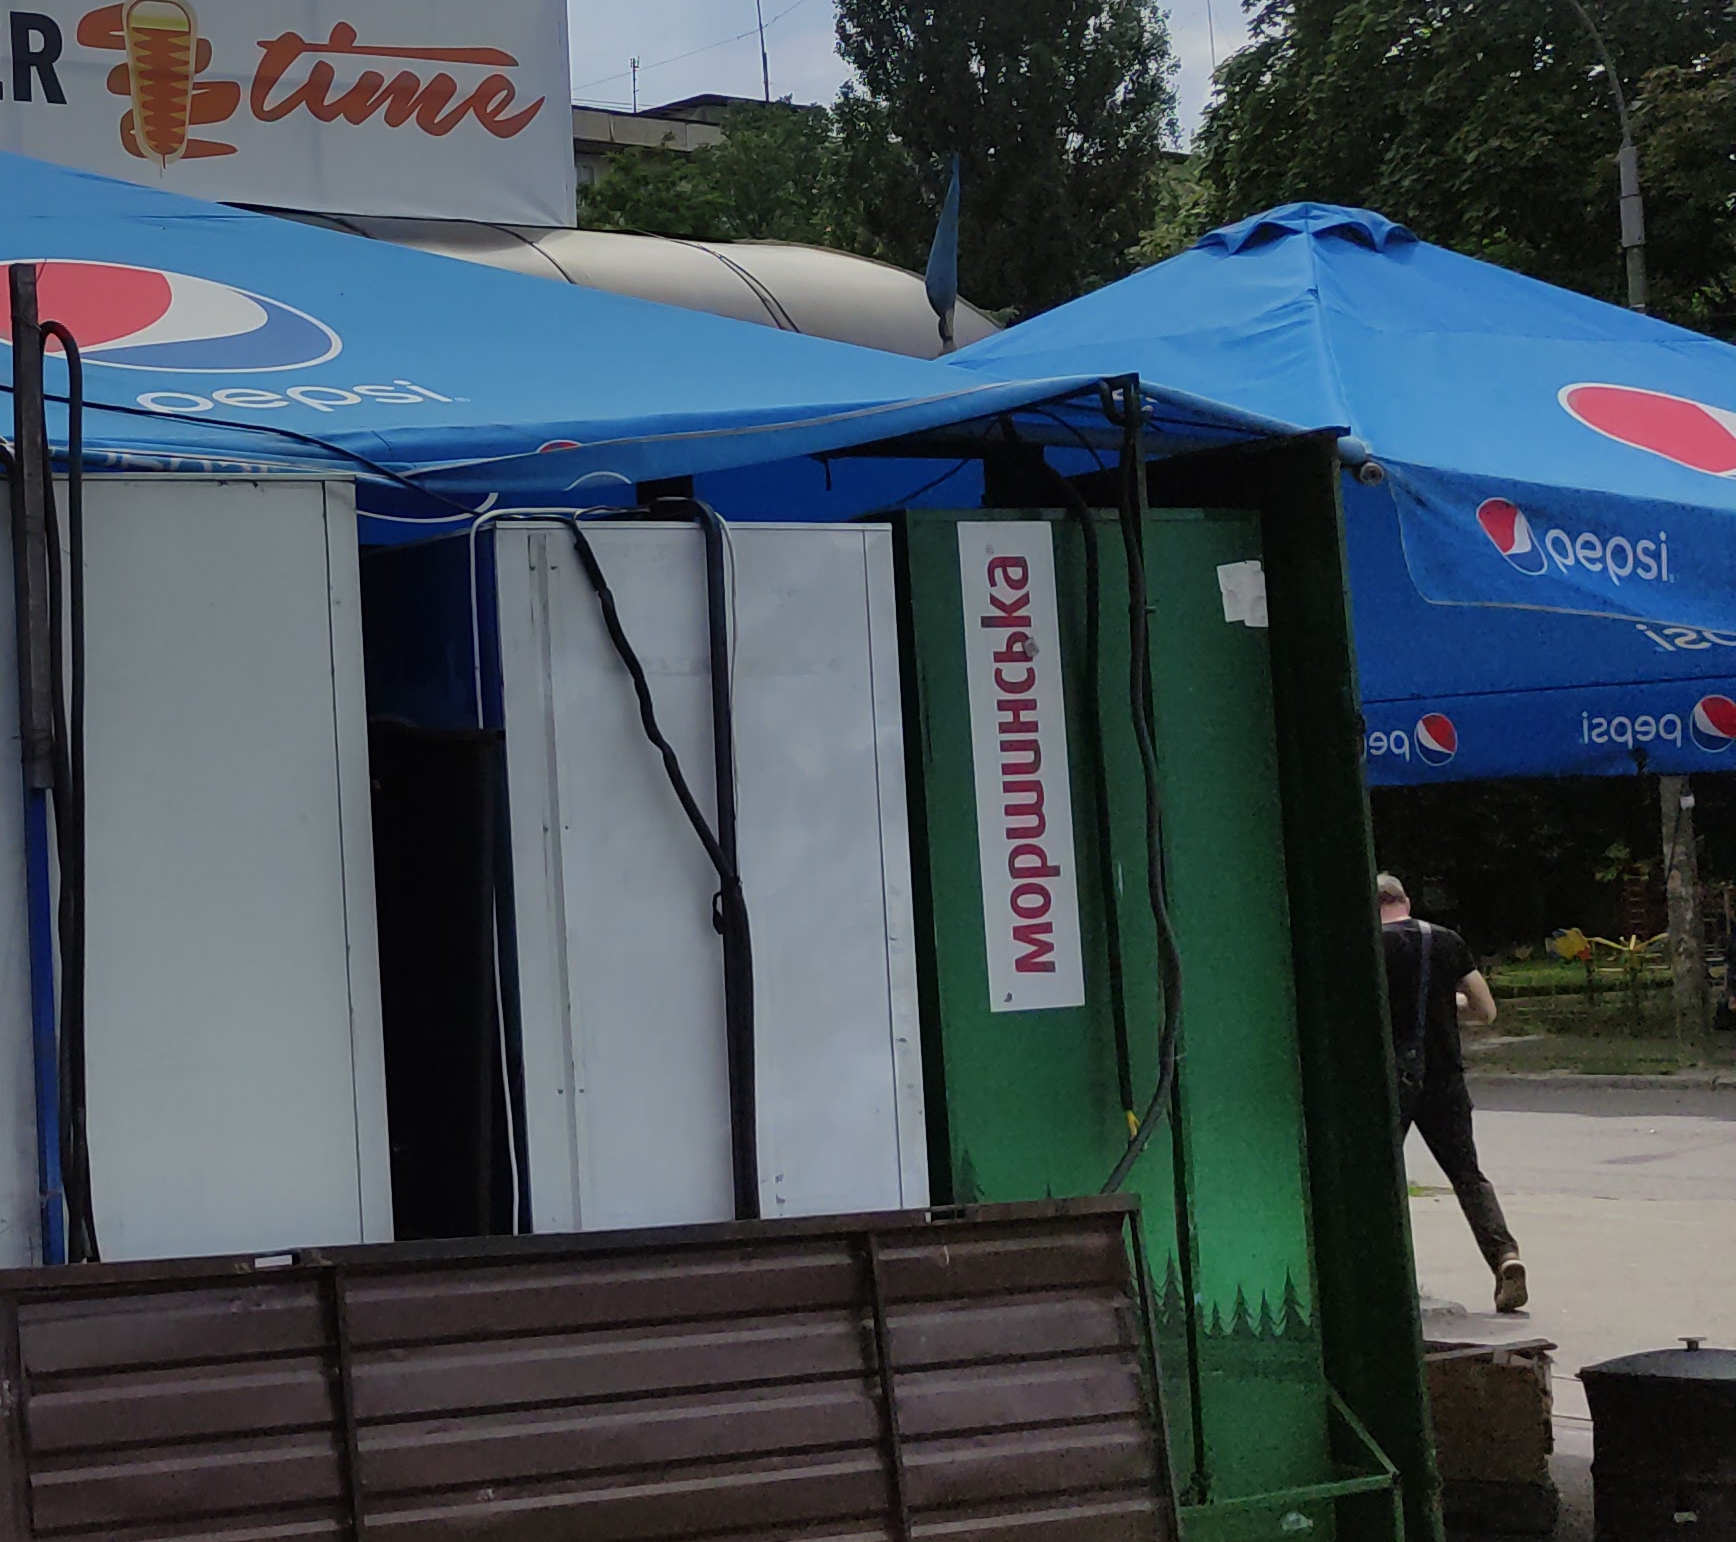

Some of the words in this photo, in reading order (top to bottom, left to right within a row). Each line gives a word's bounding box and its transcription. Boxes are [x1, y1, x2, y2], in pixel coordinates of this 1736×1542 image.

[250, 21, 545, 138] time
[136, 379, 453, 414] pepsi
[1545, 529, 1668, 585] pepsi
